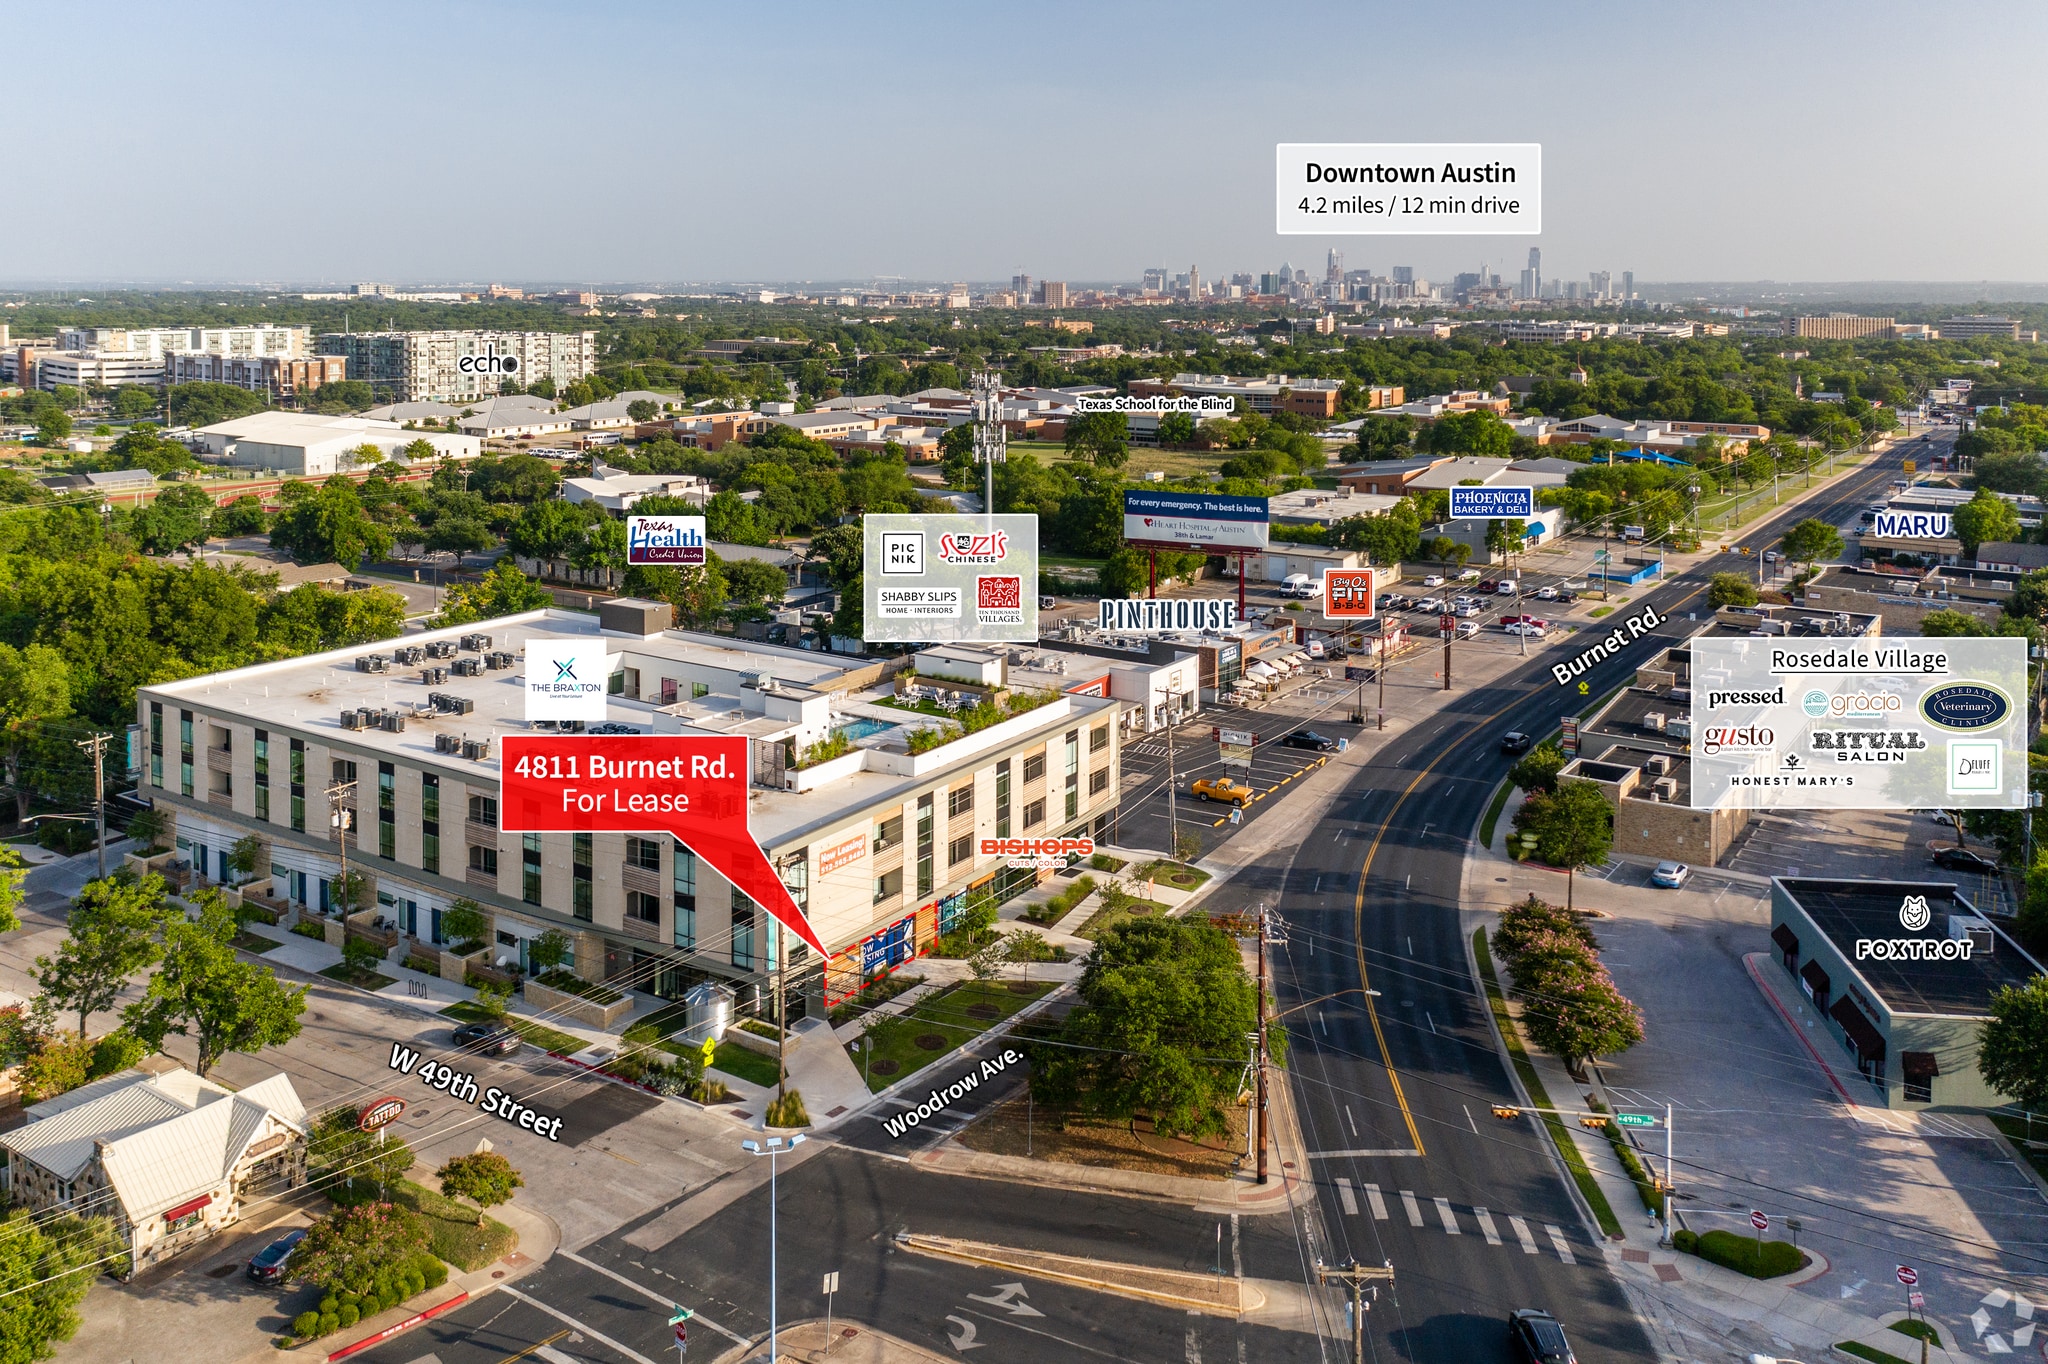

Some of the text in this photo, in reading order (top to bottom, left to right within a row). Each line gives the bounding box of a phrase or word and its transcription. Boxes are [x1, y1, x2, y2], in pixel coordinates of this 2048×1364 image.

[1128, 497, 1263, 513] For every emergency. The best is here.
[1195, 533, 1214, 541] Lamar
[821, 836, 865, 863] Now Leasing!
[863, 947, 885, 965] ASING
[369, 1104, 401, 1126] TATTOO
[1623, 1116, 1642, 1124] 49th
